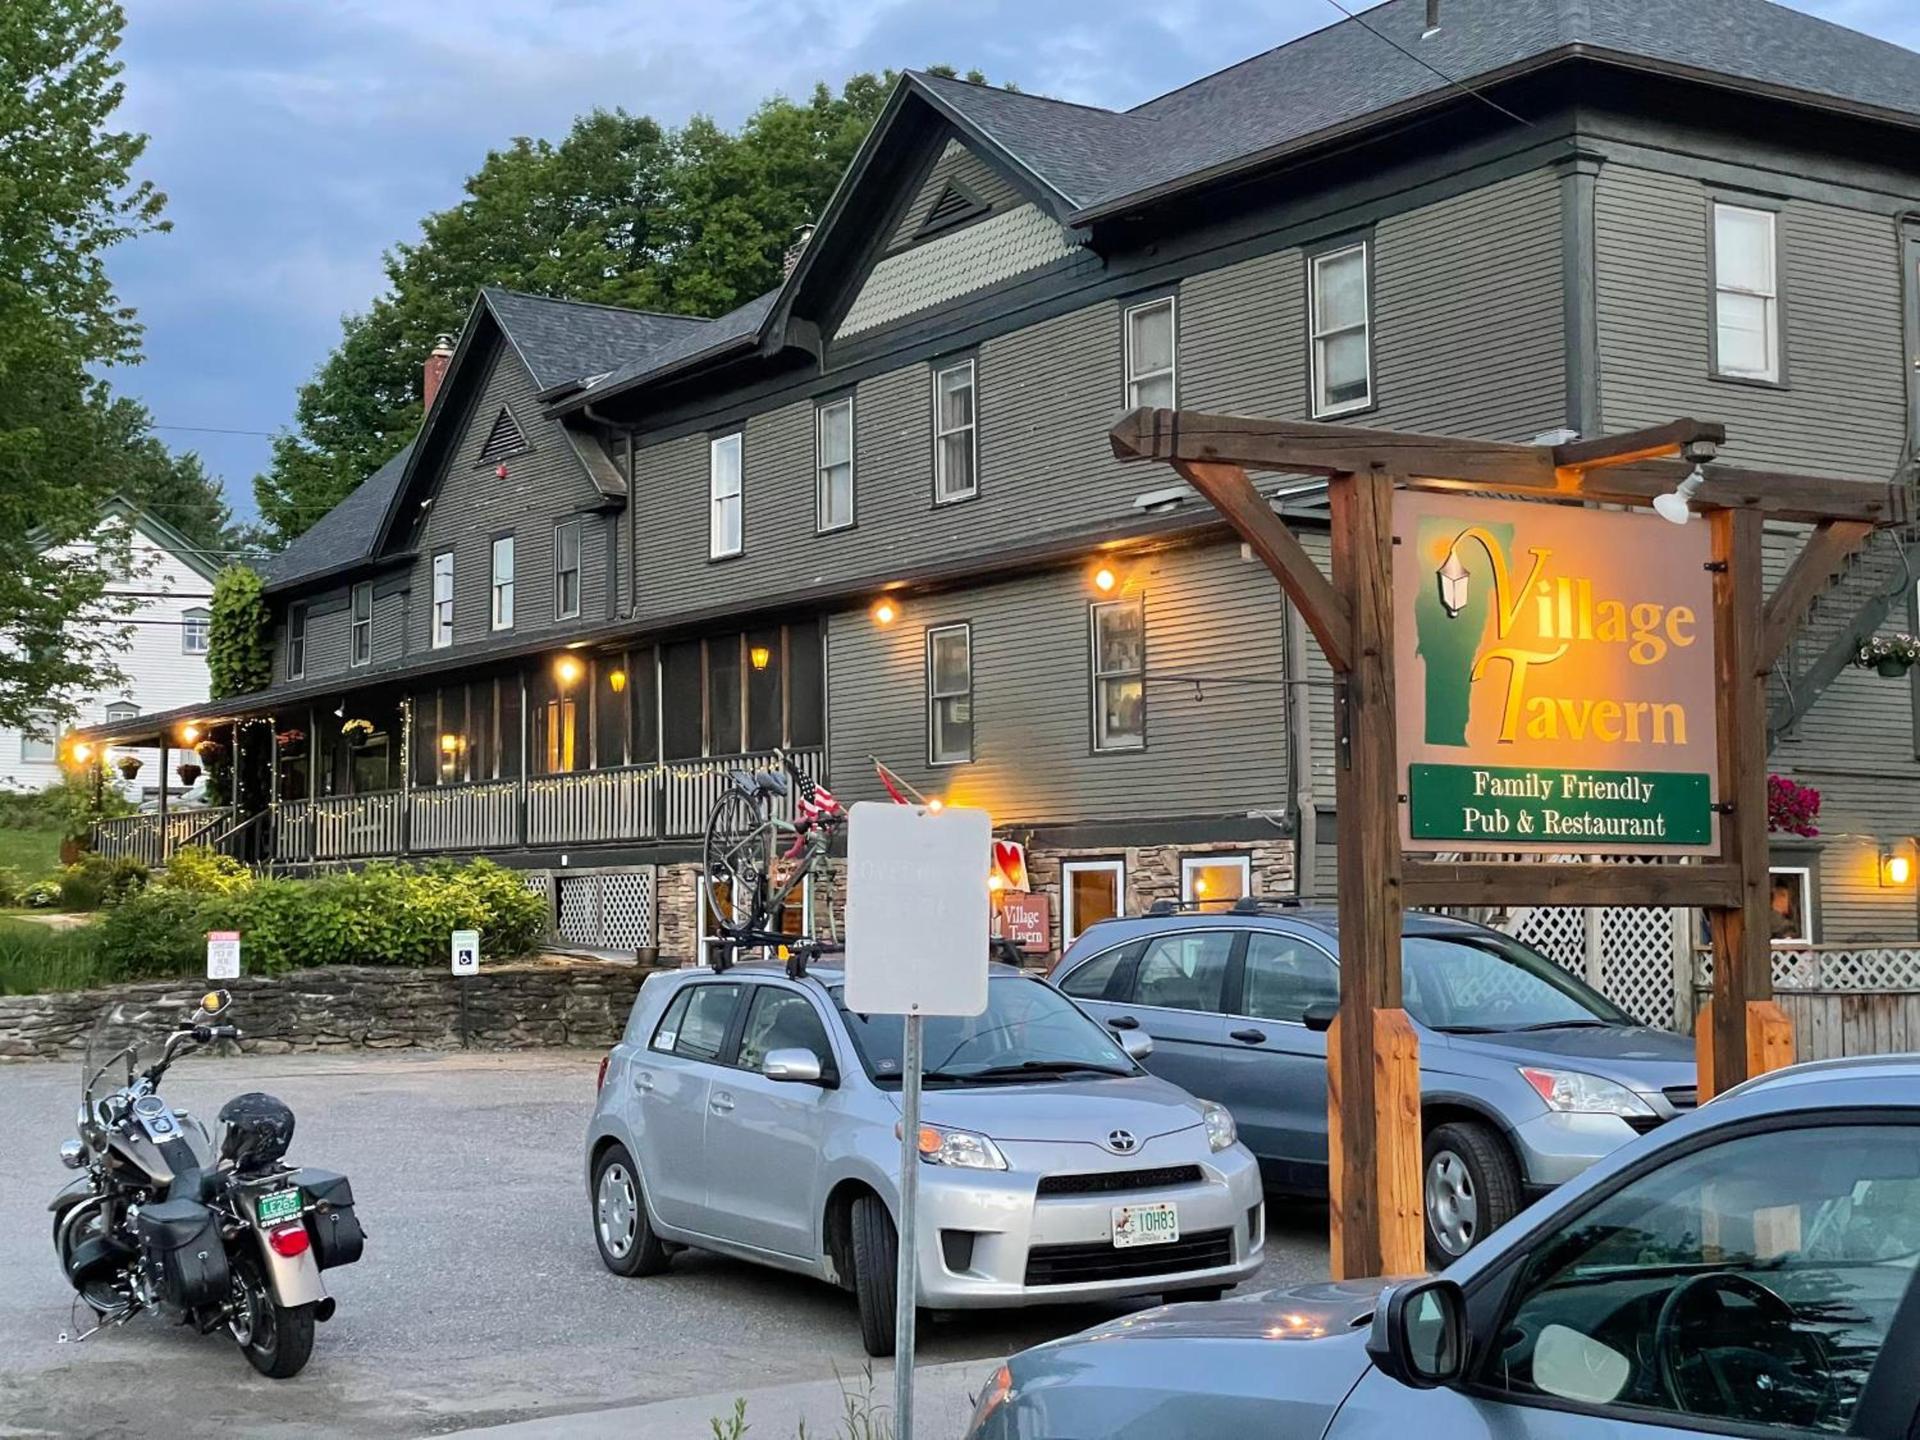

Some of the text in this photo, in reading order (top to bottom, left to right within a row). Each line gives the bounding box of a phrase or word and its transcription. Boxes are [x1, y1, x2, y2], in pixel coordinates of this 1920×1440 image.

[1450, 527, 1695, 665] Village
[1471, 642, 1688, 745] Tavern
[1472, 770, 1655, 804] Family Friendly
[1462, 807, 1666, 837] Pub & Restaurant
[1004, 905, 1039, 928] Village
[1009, 925, 1042, 942] Tavern
